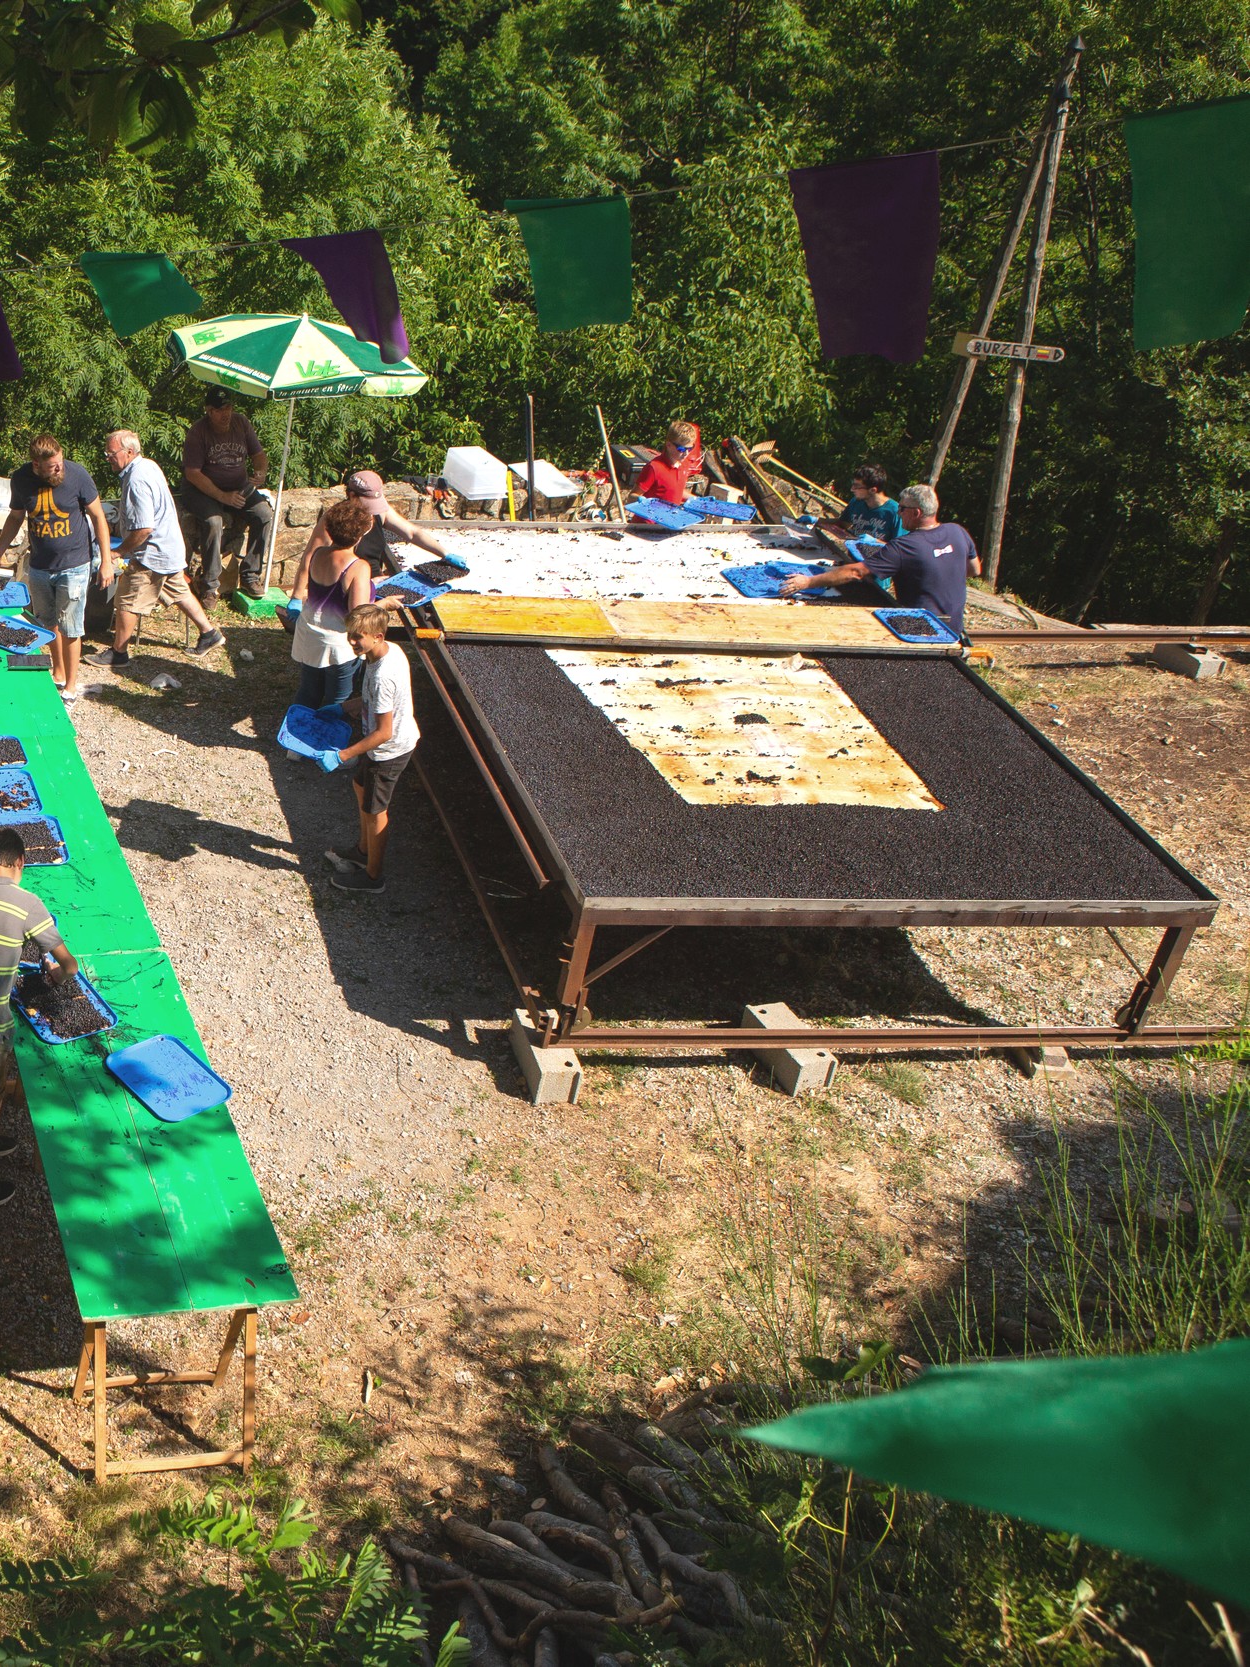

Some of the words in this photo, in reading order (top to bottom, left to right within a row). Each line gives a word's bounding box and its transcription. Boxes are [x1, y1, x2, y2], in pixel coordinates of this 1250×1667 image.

[973, 341, 1036, 358] BURZET
[294, 359, 341, 378] Vals
[290, 387, 320, 396] nature
[321, 385, 333, 393] en
[30, 519, 71, 538] ATARI
